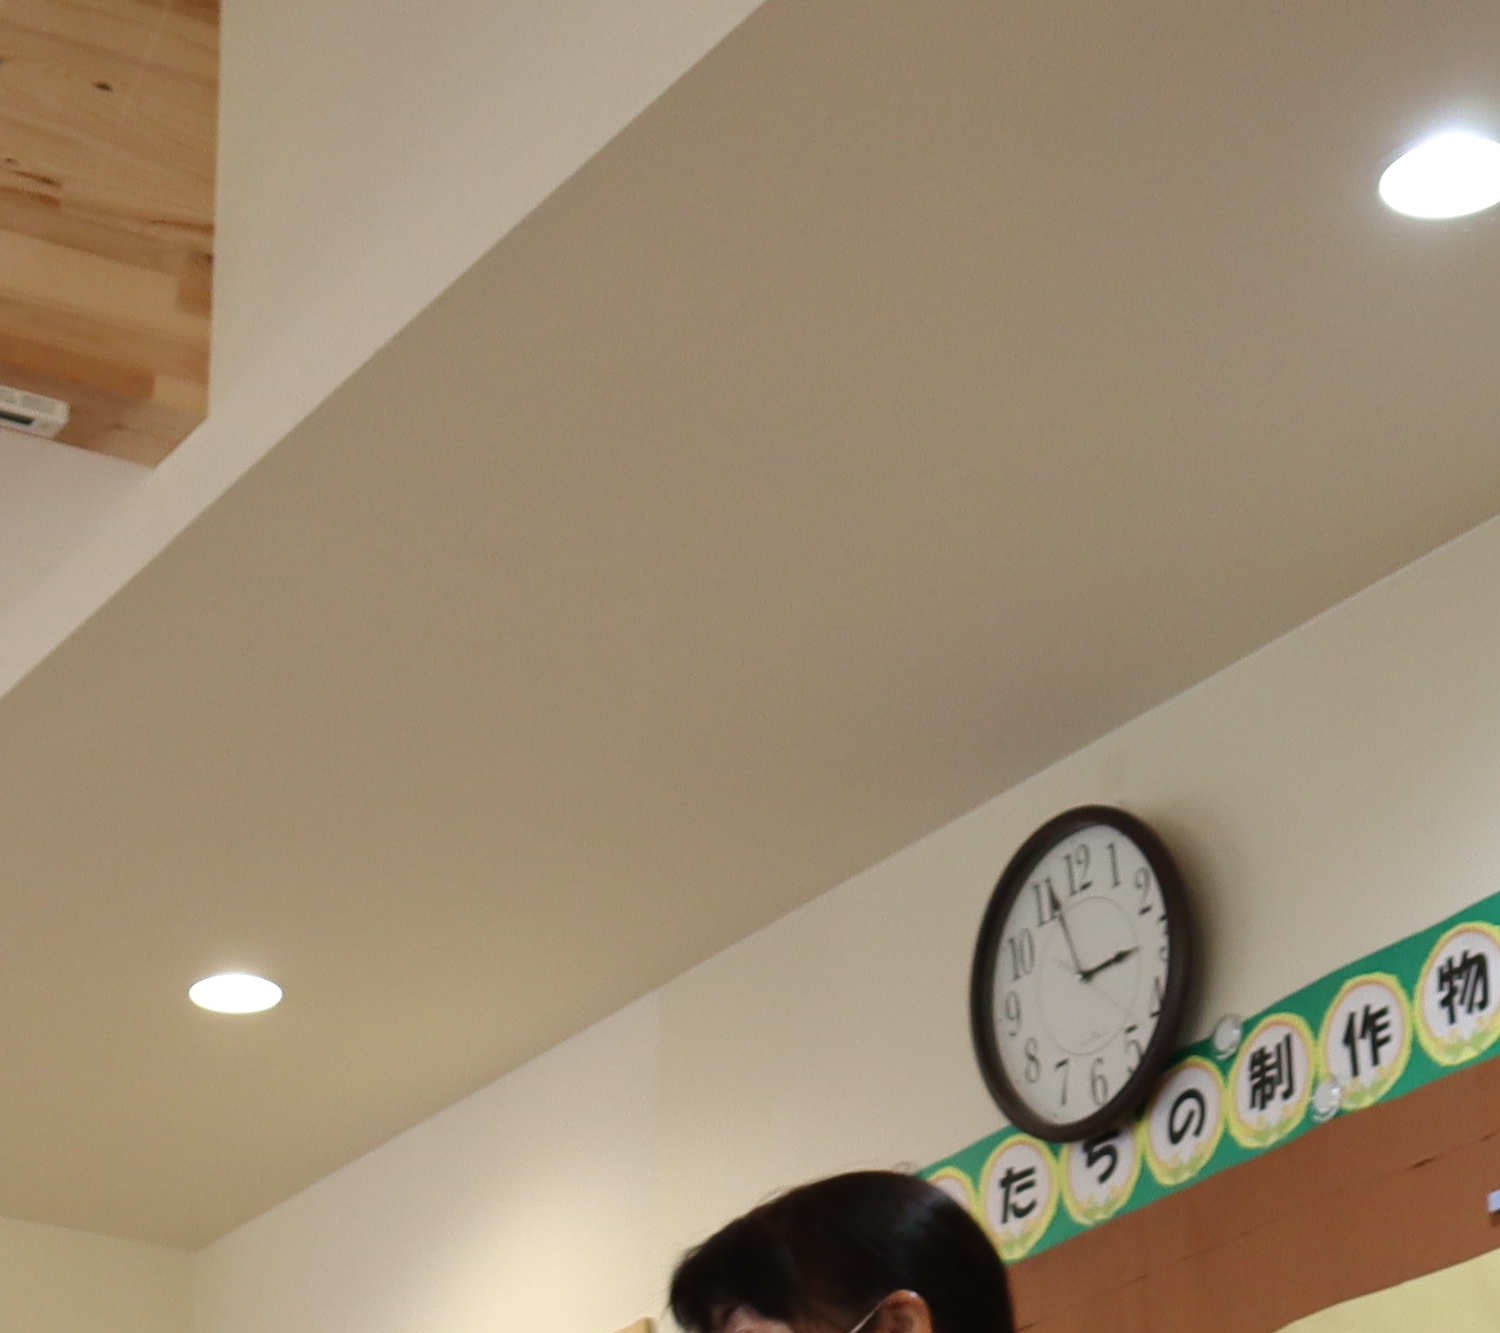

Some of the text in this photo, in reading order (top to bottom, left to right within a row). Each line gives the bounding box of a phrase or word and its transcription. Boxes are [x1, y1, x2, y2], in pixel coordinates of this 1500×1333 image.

[1064, 843, 1092, 897] 12
[1107, 842, 1121, 888] 1
[1135, 866, 1152, 916] 2
[1008, 927, 1035, 981] 10
[1004, 990, 1021, 1037] 9
[1024, 1036, 1040, 1084] 8
[1055, 1058, 1069, 1106] 7
[1091, 1057, 1109, 1106] 6
